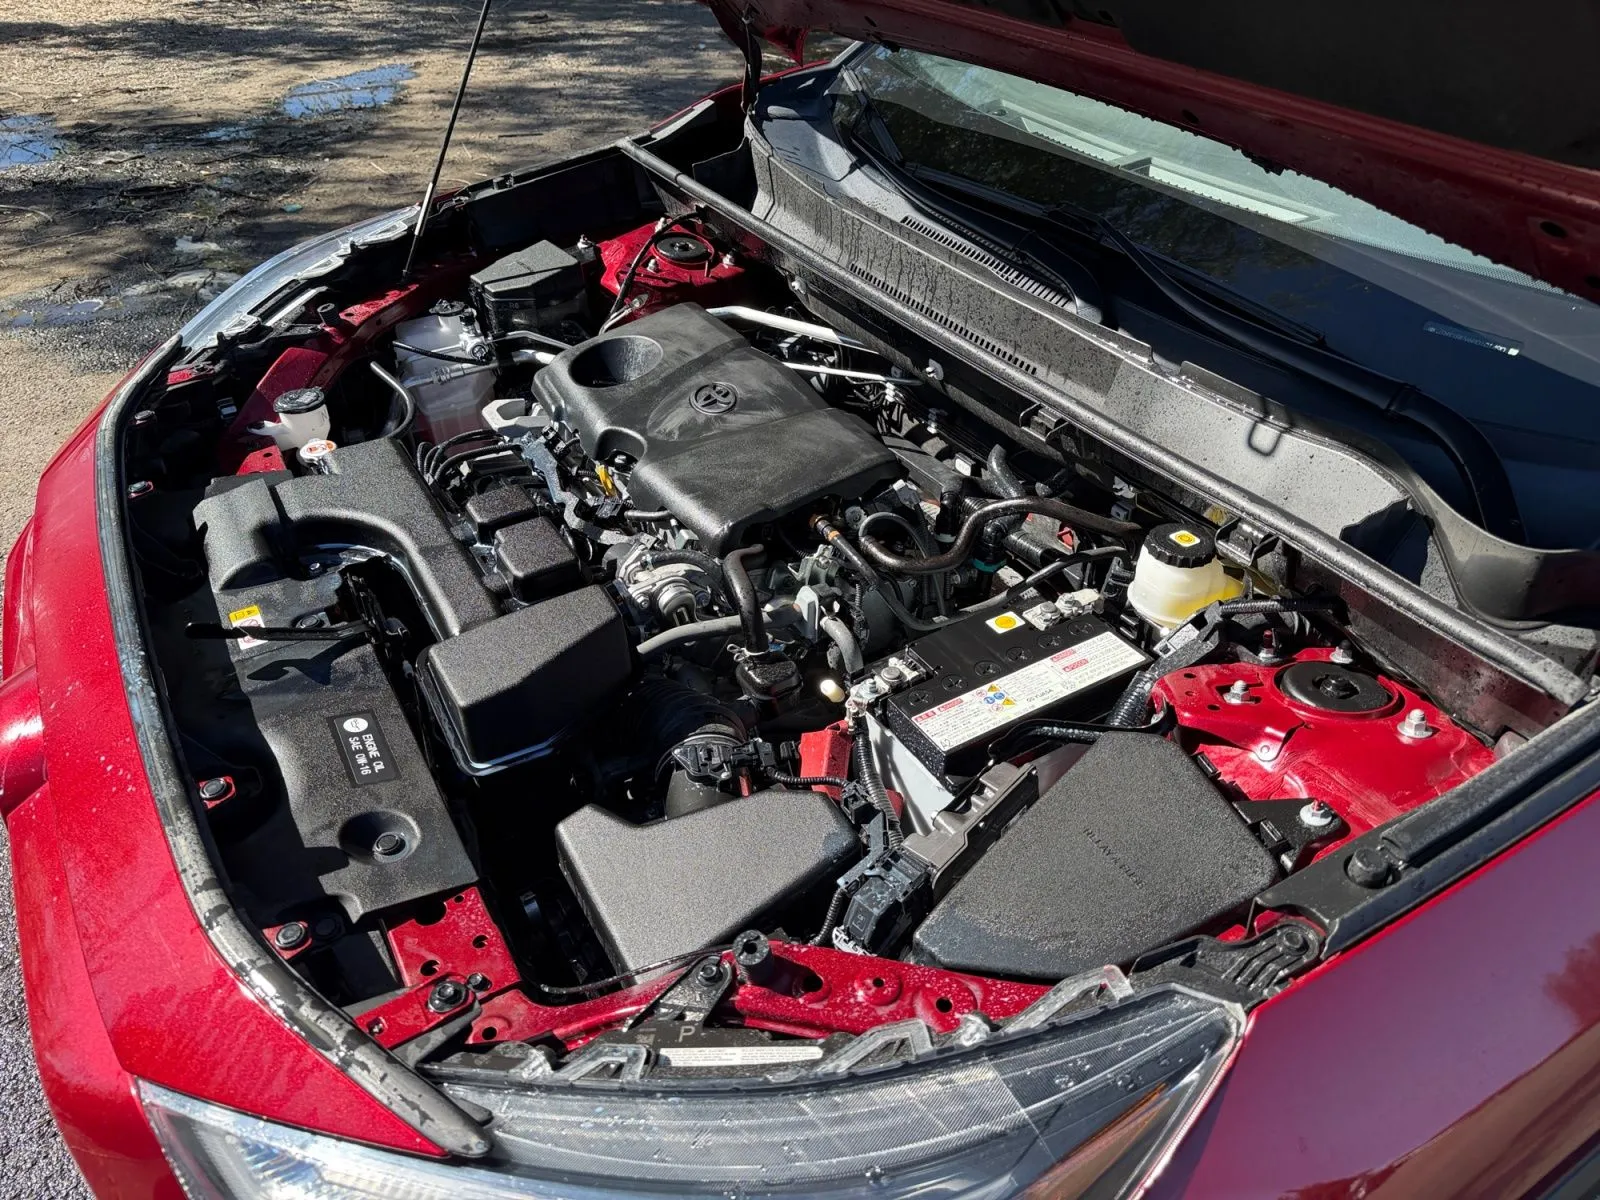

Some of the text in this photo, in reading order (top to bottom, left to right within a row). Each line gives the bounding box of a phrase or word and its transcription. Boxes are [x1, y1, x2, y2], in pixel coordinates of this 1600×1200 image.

[348, 736, 372, 776] SAE 0W-16
[362, 733, 385, 773] ENGINE OIL
[678, 1025, 696, 1043] P
